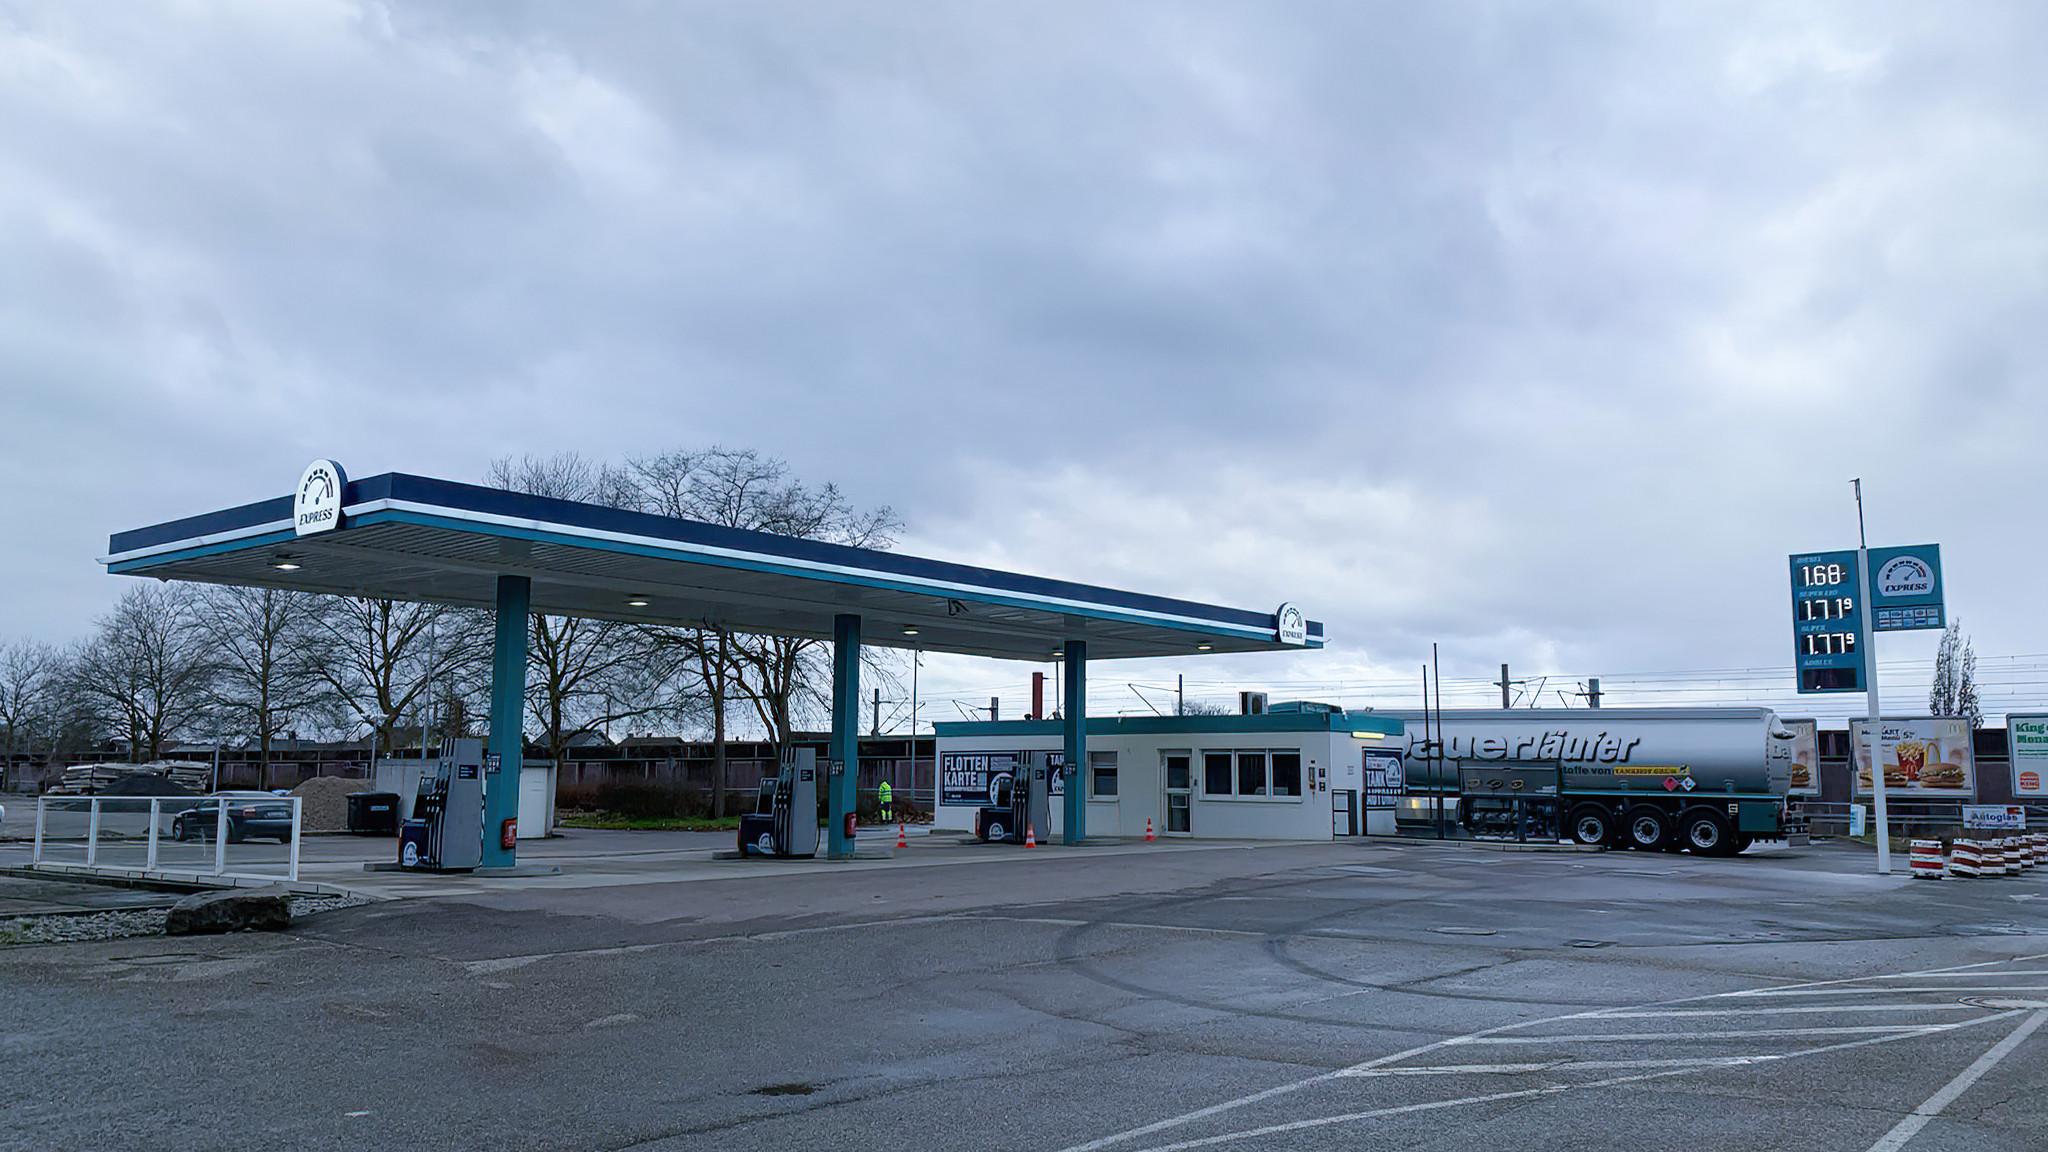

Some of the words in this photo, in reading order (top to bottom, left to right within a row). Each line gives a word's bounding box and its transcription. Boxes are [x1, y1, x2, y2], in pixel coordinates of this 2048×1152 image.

[299, 508, 333, 526] EXPRESS
[1885, 582, 1928, 593] EXPRESS
[1801, 624, 1826, 632] SUPER
[2015, 723, 2045, 734] King
[944, 755, 989, 771] FLOTTEN
[1591, 767, 1611, 775] von
[944, 771, 977, 787] KARTE
[1971, 812, 2018, 823] Autoglas
